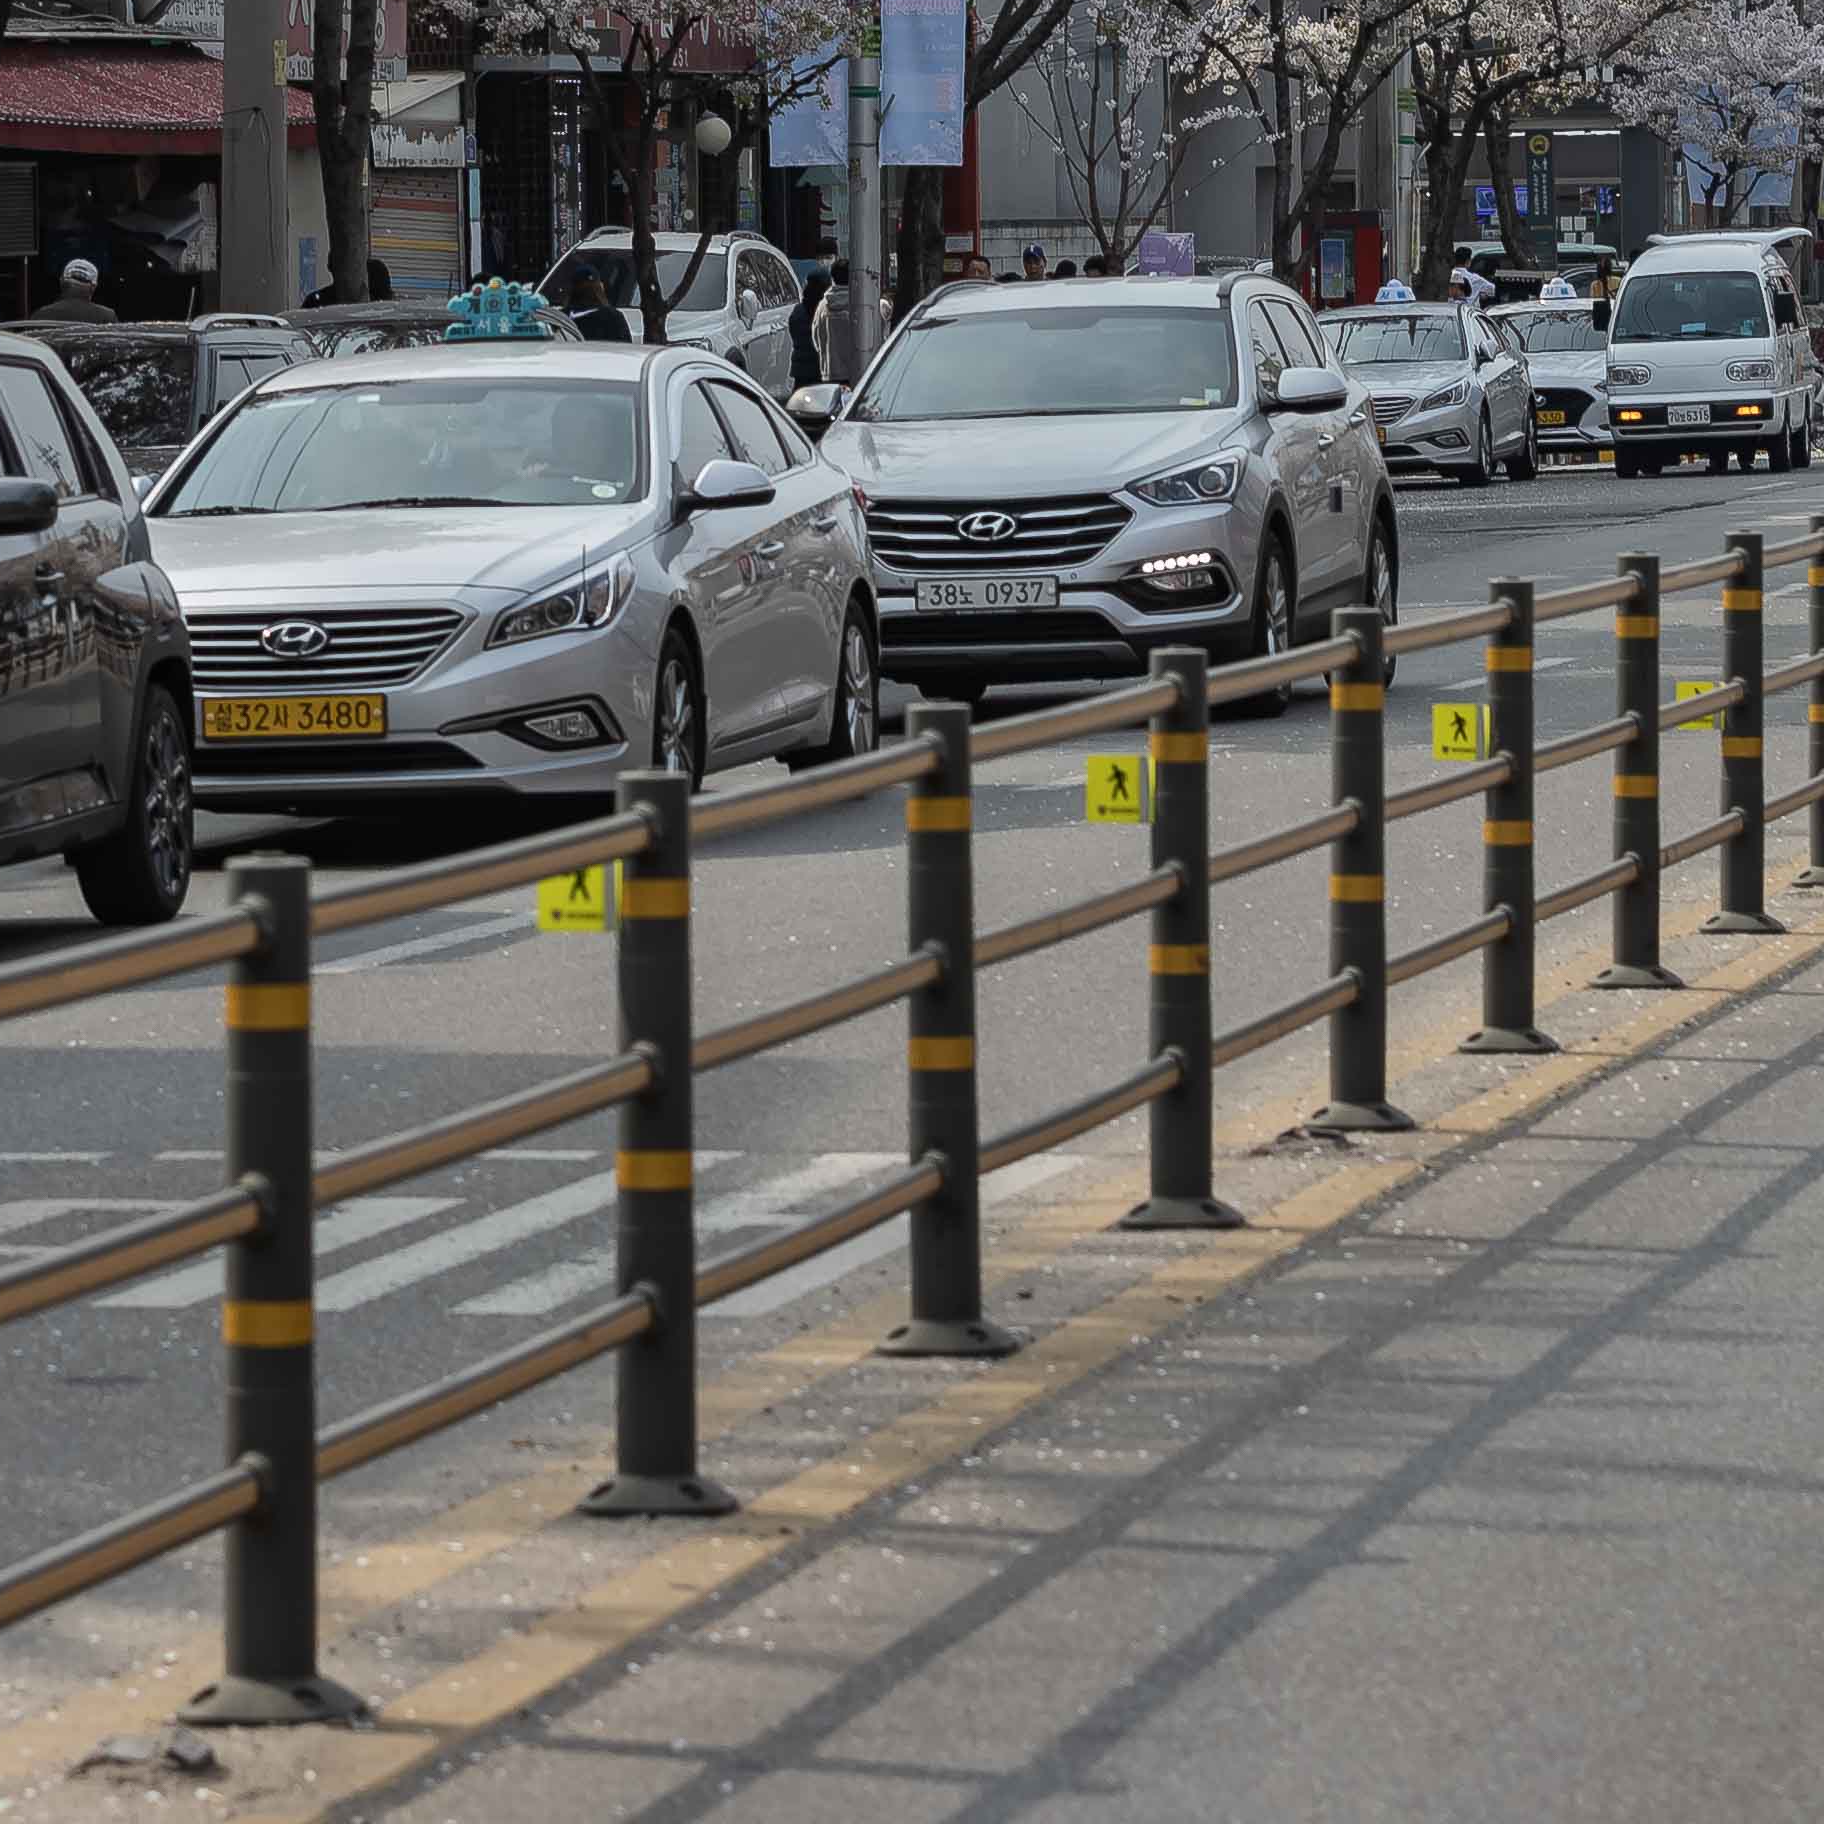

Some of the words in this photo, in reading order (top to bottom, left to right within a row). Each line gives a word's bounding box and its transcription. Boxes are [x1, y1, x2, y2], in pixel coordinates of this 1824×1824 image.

[929, 583, 974, 606] 38노
[985, 581, 1044, 605] 0937
[297, 700, 372, 730] 3480
